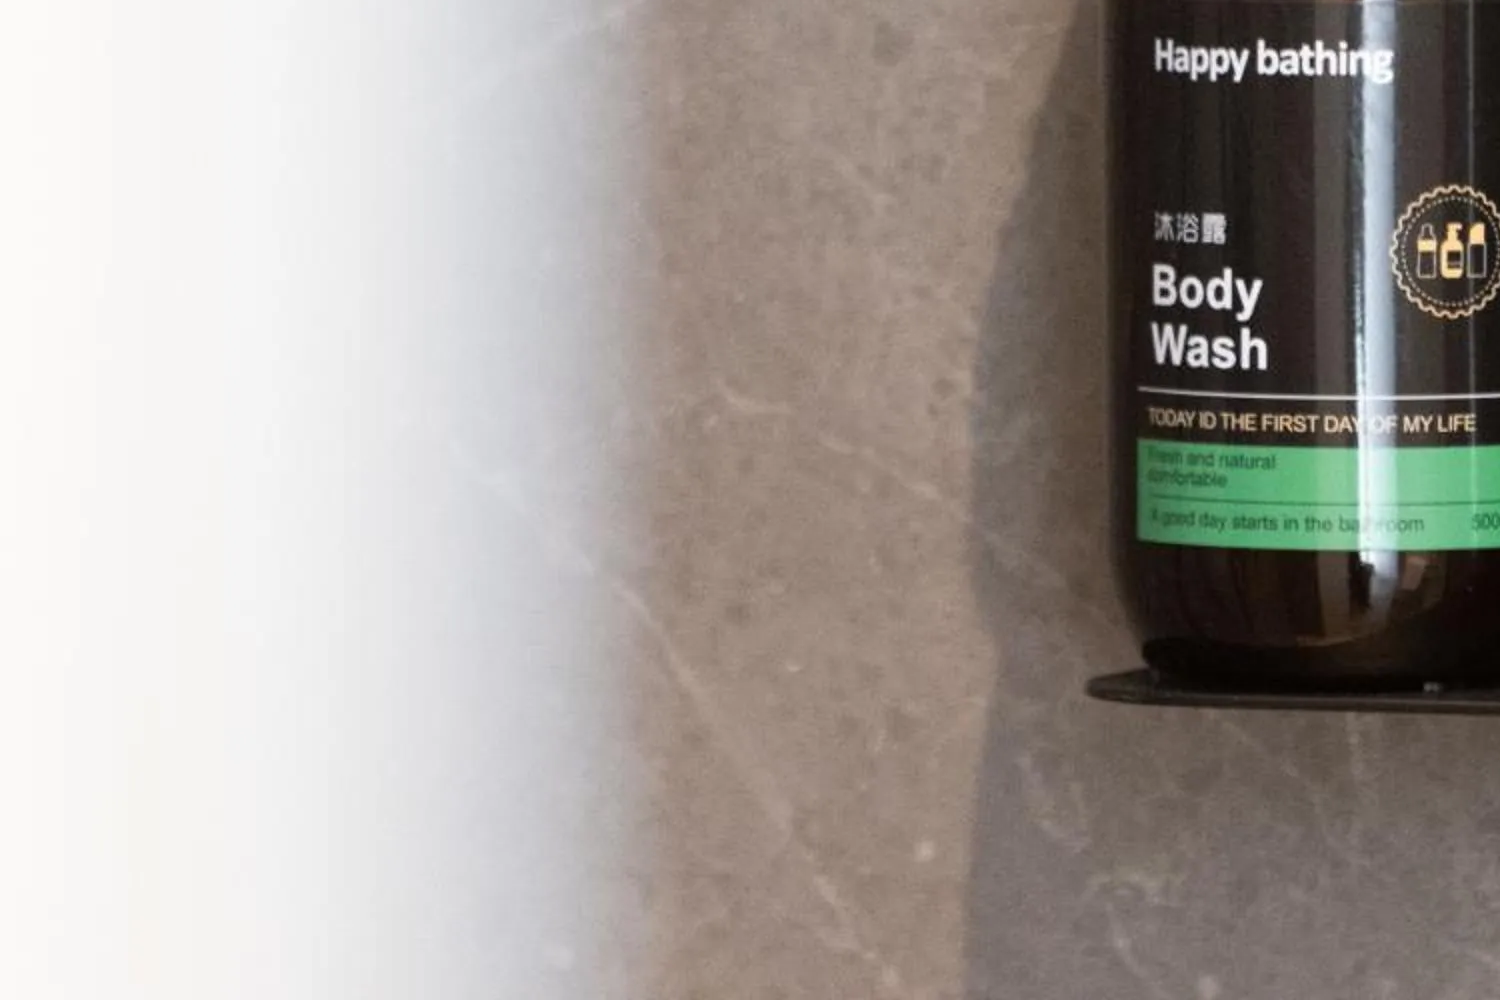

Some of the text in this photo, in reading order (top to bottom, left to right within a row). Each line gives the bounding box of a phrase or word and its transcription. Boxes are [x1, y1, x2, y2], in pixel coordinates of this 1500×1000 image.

[1154, 37, 1395, 84] Happy bathing
[1154, 211, 1228, 245] 沐浴露
[1152, 263, 1263, 322] Body
[1151, 322, 1268, 371] Wash
[1147, 407, 1477, 435] TODAY ID THE FIRST DAY OF MY LIFE
[1186, 451, 1215, 468] and
[1219, 453, 1276, 470] natural
[1162, 510, 1195, 529] good
[1199, 513, 1225, 532] day
[1231, 515, 1279, 532] starts
[1283, 515, 1299, 531] in
[1304, 515, 1331, 532] the
[1339, 516, 1425, 534] baroom
